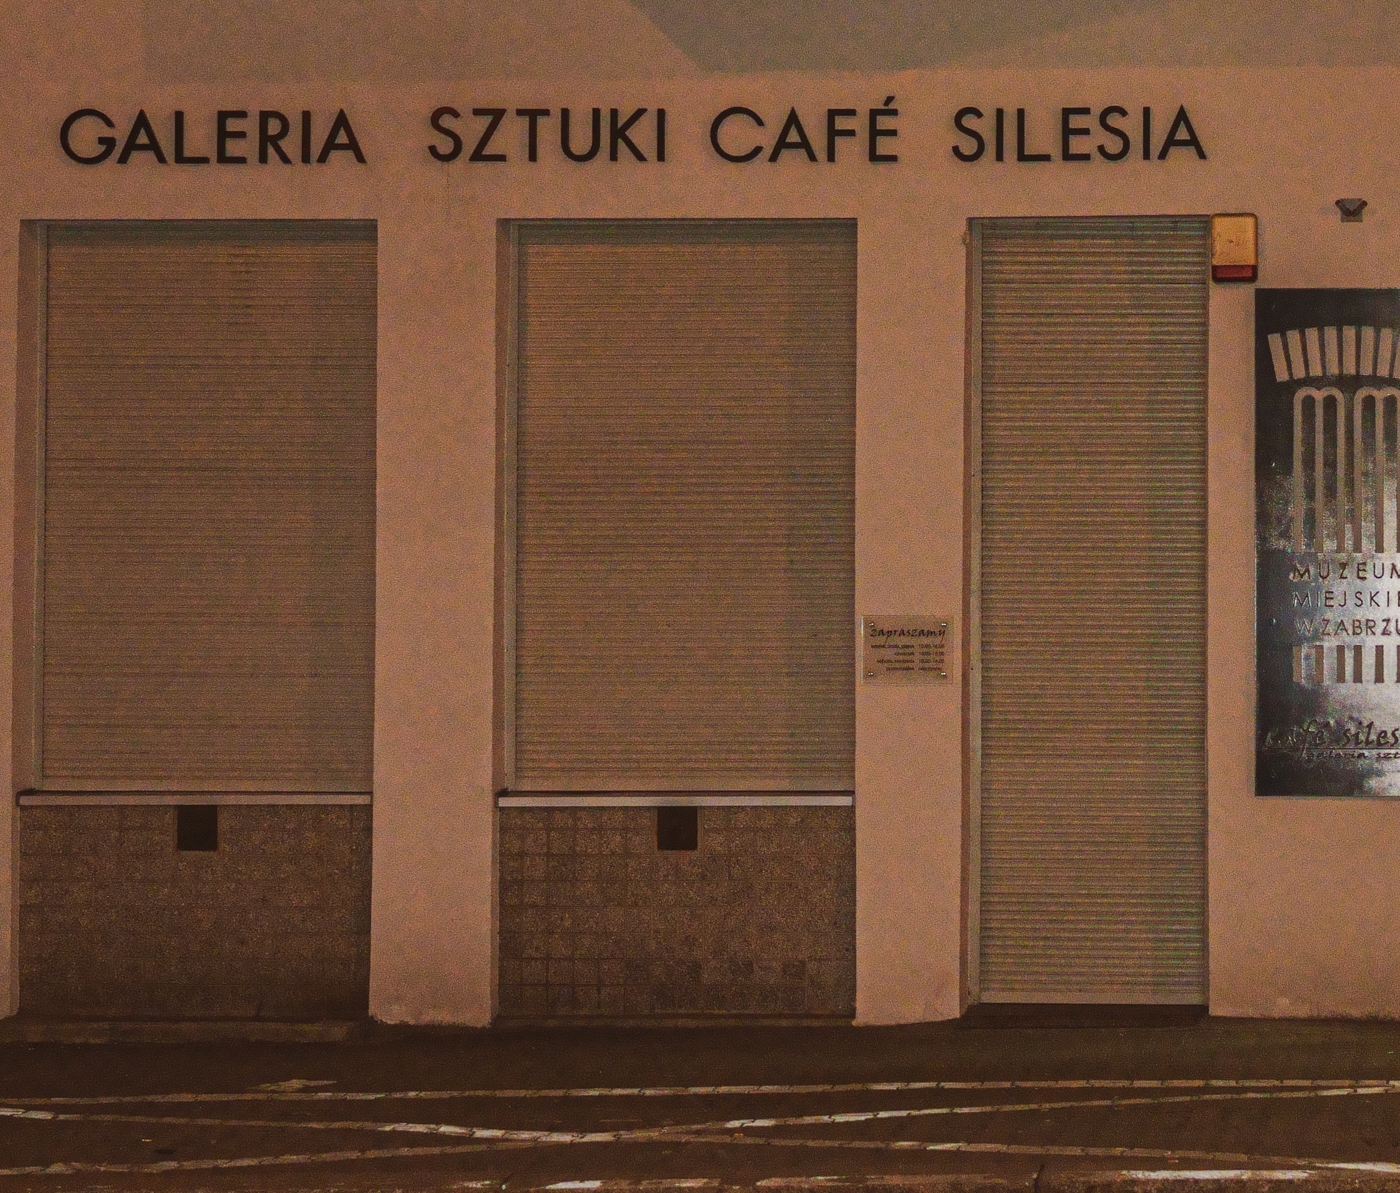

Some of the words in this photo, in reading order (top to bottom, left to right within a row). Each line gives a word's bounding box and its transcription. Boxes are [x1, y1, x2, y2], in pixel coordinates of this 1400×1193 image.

[59, 108, 367, 166] GALERIA
[427, 106, 667, 163] SZTUKI
[709, 95, 899, 164] CAFÉ
[951, 105, 1207, 163] SILESIA
[1295, 618, 1314, 637] W
